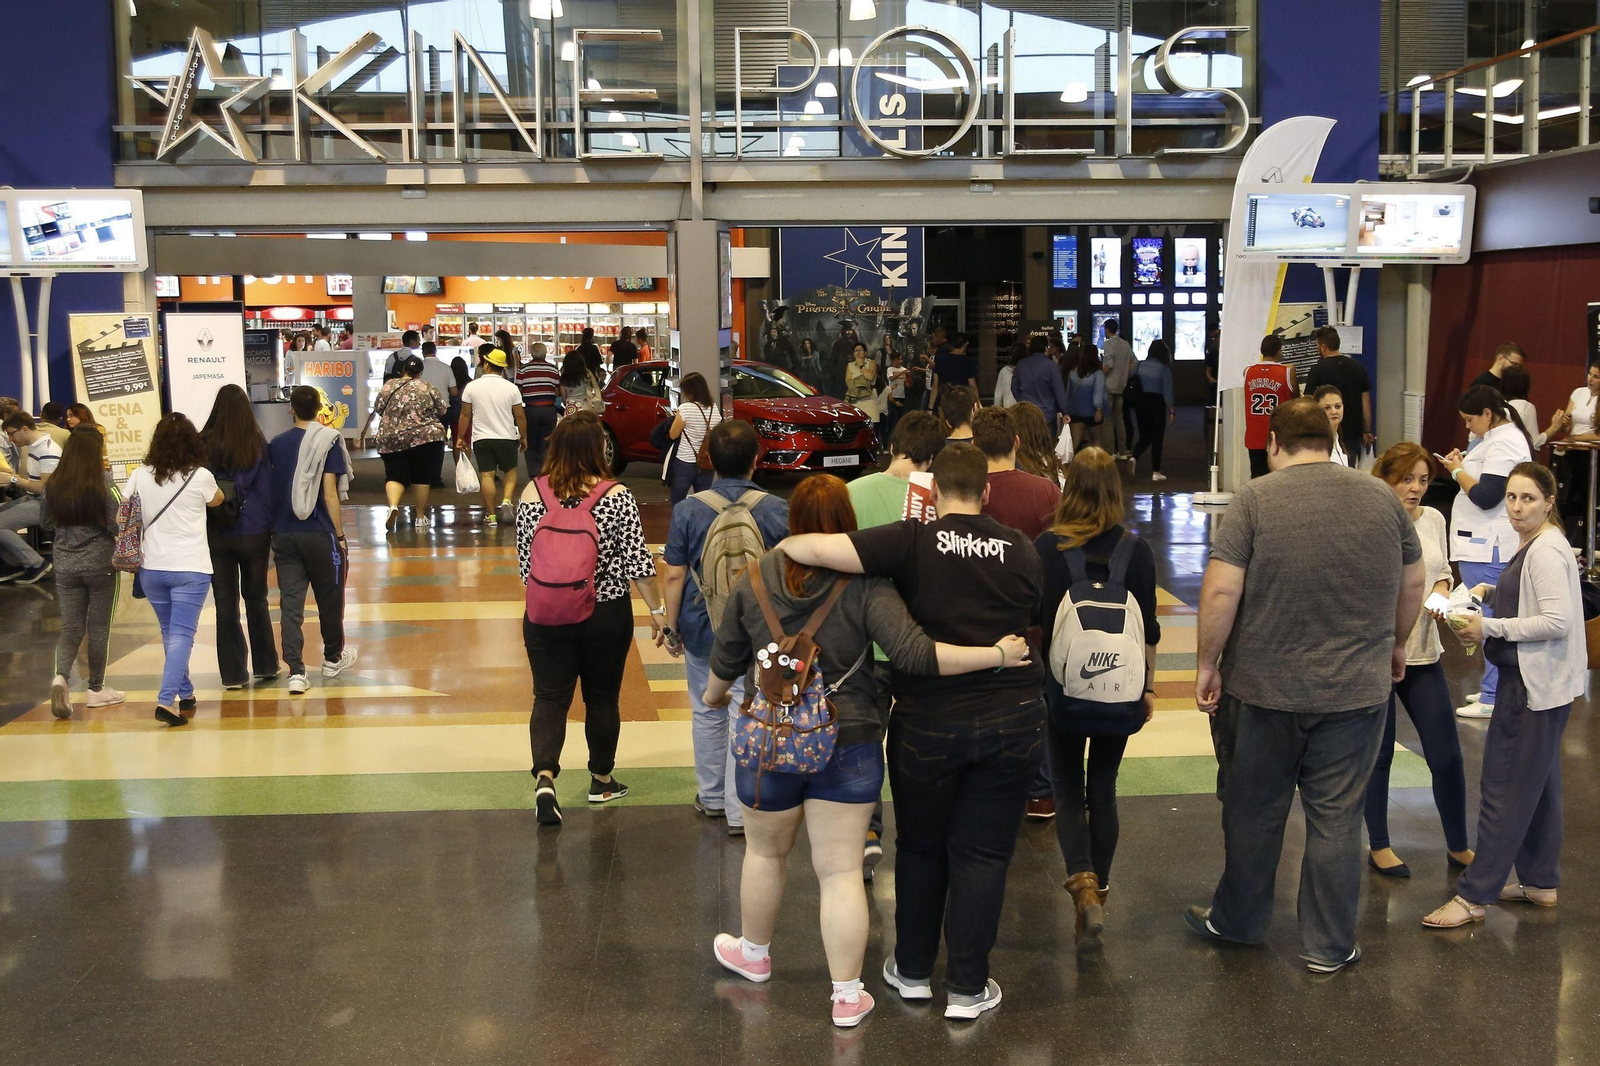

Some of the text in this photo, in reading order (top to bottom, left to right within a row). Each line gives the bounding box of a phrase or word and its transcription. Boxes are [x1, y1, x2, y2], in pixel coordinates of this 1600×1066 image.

[878, 93, 907, 158] LIS
[881, 226, 908, 287] KIN
[795, 304, 838, 313] PIRATAS
[187, 356, 227, 364] RENAULT
[245, 349, 271, 357] USCAMOS
[246, 356, 271, 365] MIGOS
[304, 361, 353, 378] HARIBO
[1247, 378, 1282, 392] JORDAN
[98, 402, 144, 417] CENA
[1250, 392, 1279, 416] 23
[116, 417, 129, 430] &
[106, 430, 142, 444] CINE
[831, 457, 852, 465] MEGANE
[909, 491, 924, 523] MUY
[1087, 651, 1120, 668] NIKE
[1087, 682, 1121, 693] AIR
